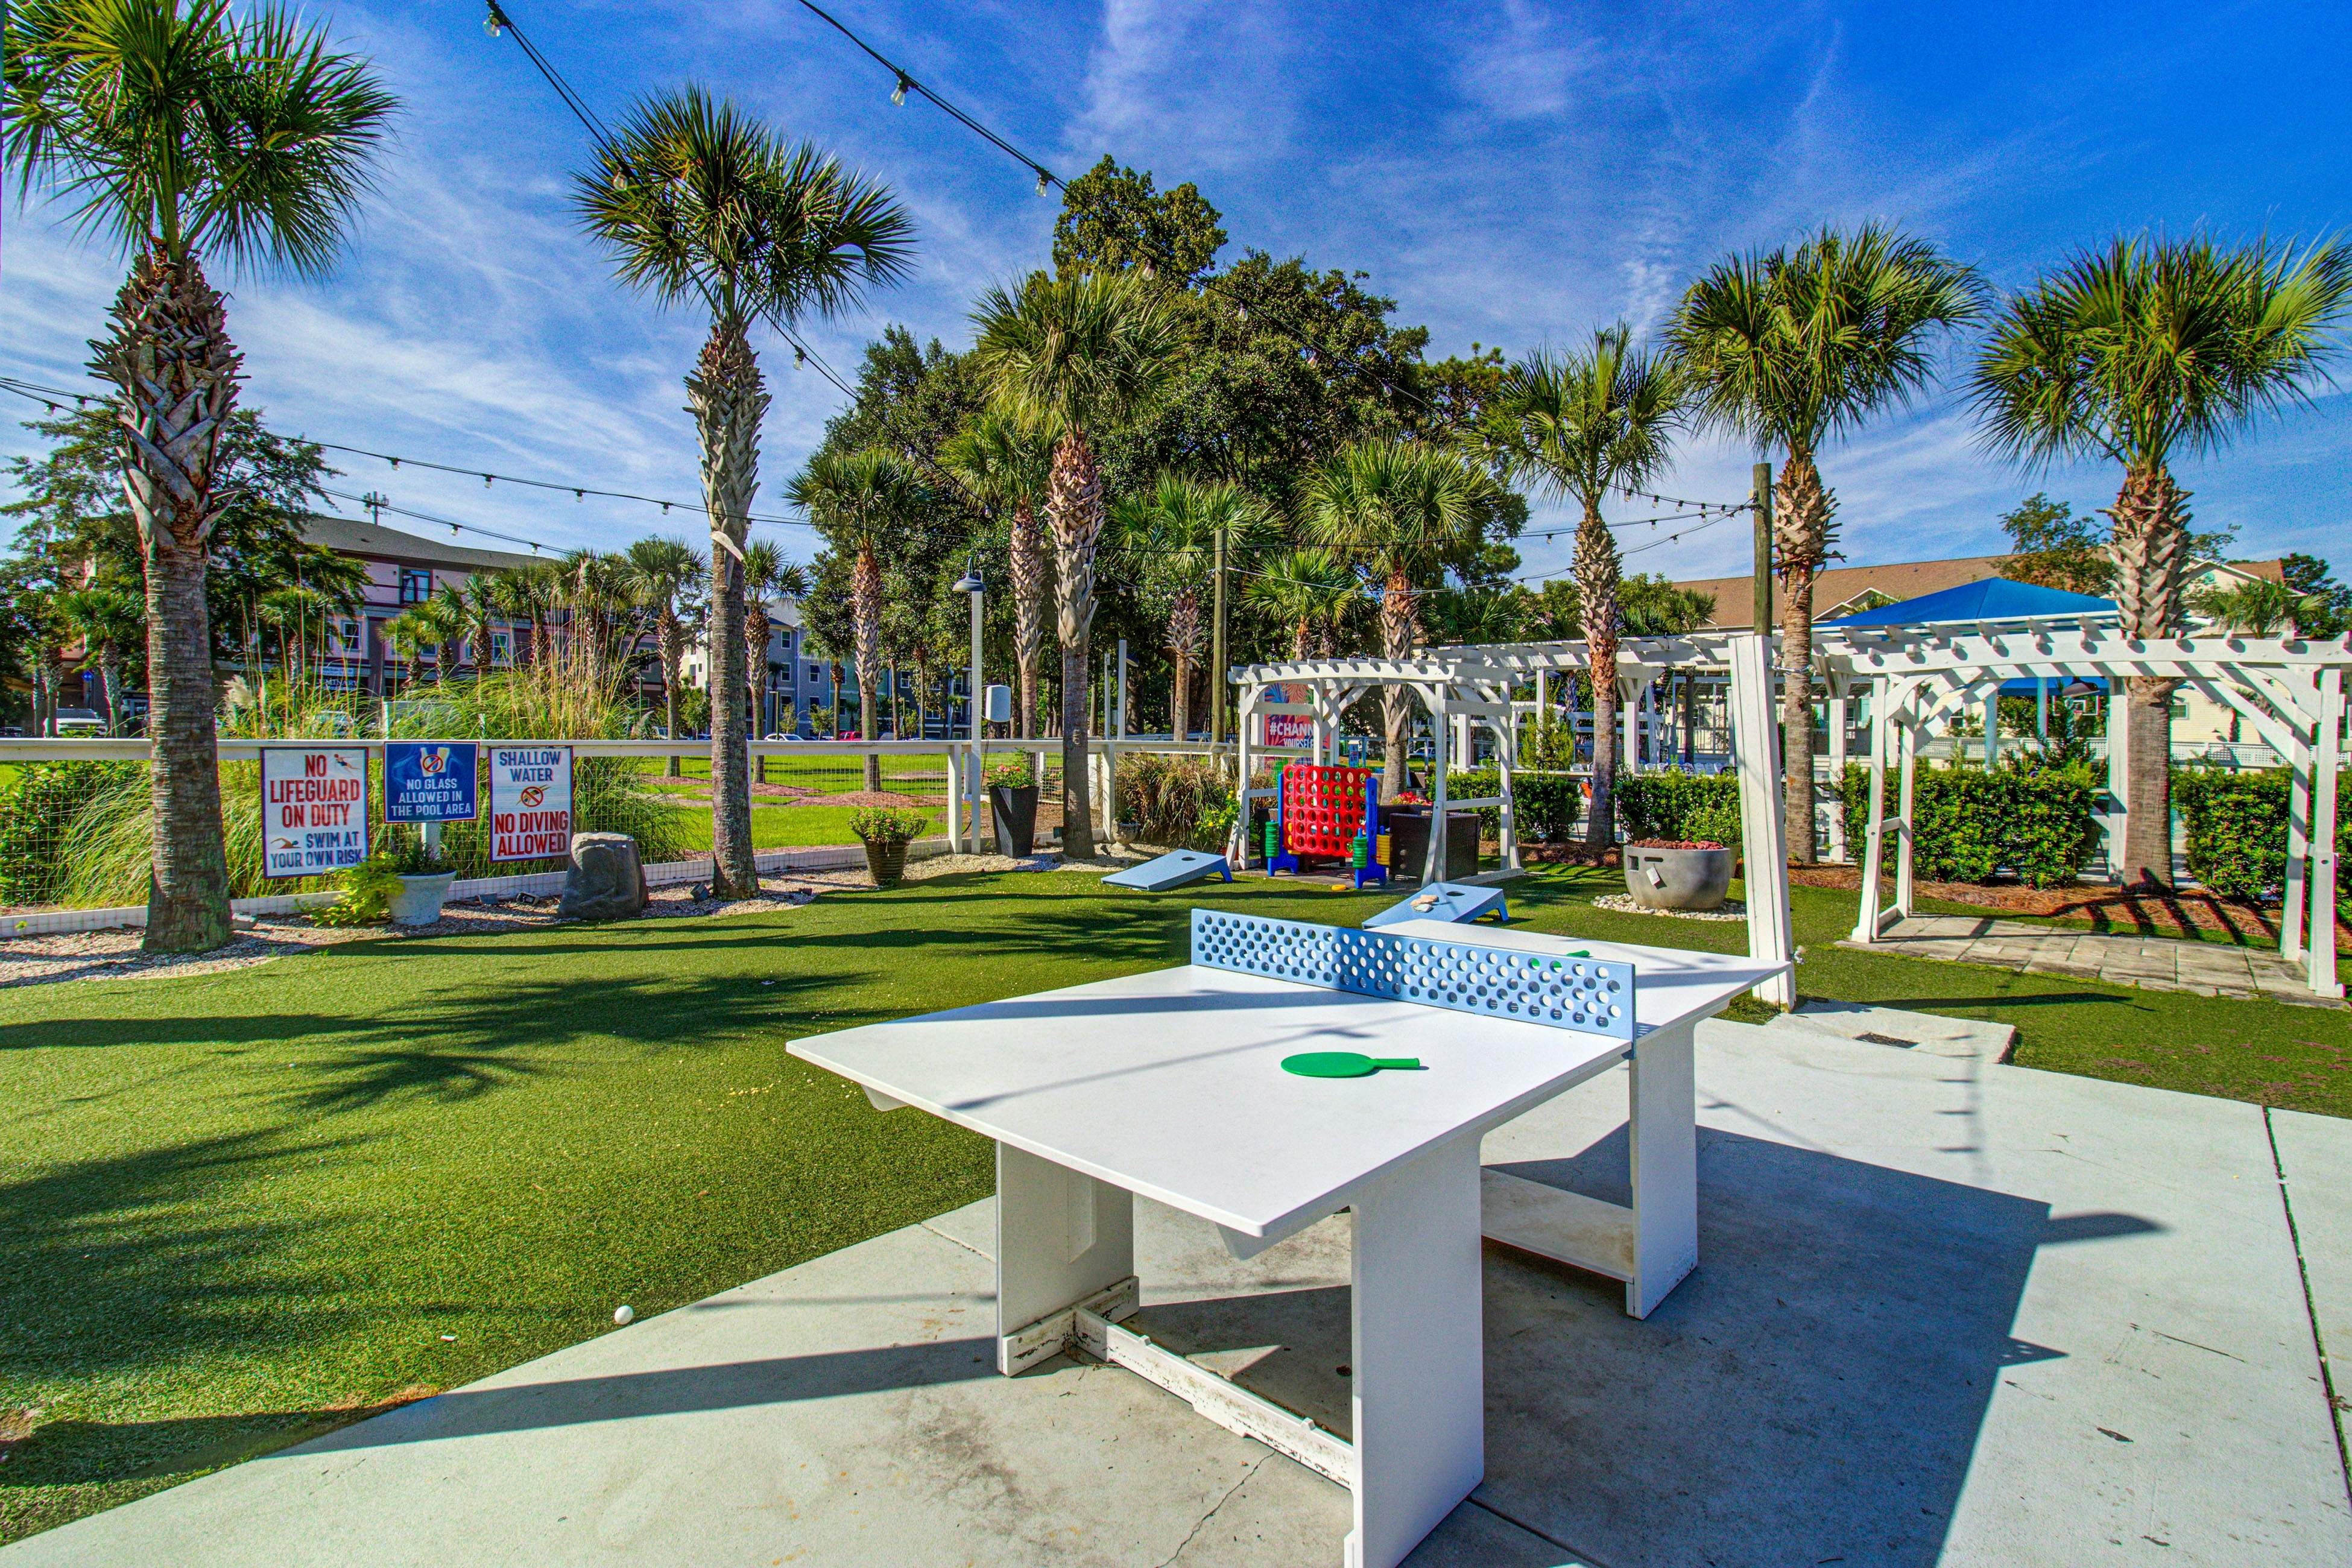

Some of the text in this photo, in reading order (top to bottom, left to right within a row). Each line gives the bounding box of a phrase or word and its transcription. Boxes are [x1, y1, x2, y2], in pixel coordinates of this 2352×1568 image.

[305, 754, 326, 777] NO
[499, 751, 561, 766] SHALLOW
[406, 778, 458, 790] NO GLASS
[510, 768, 554, 782] WATER
[270, 779, 359, 803] LIFEGUARD
[398, 791, 463, 803] ALLOWED IN
[282, 803, 350, 827] ON DUTY
[391, 803, 472, 816] THE POOL AREA
[495, 811, 569, 834] NO DIVING
[306, 831, 359, 849] SWIM AT
[497, 832, 566, 856] ALLOWED
[271, 849, 362, 868] YOUR OWN RISK
